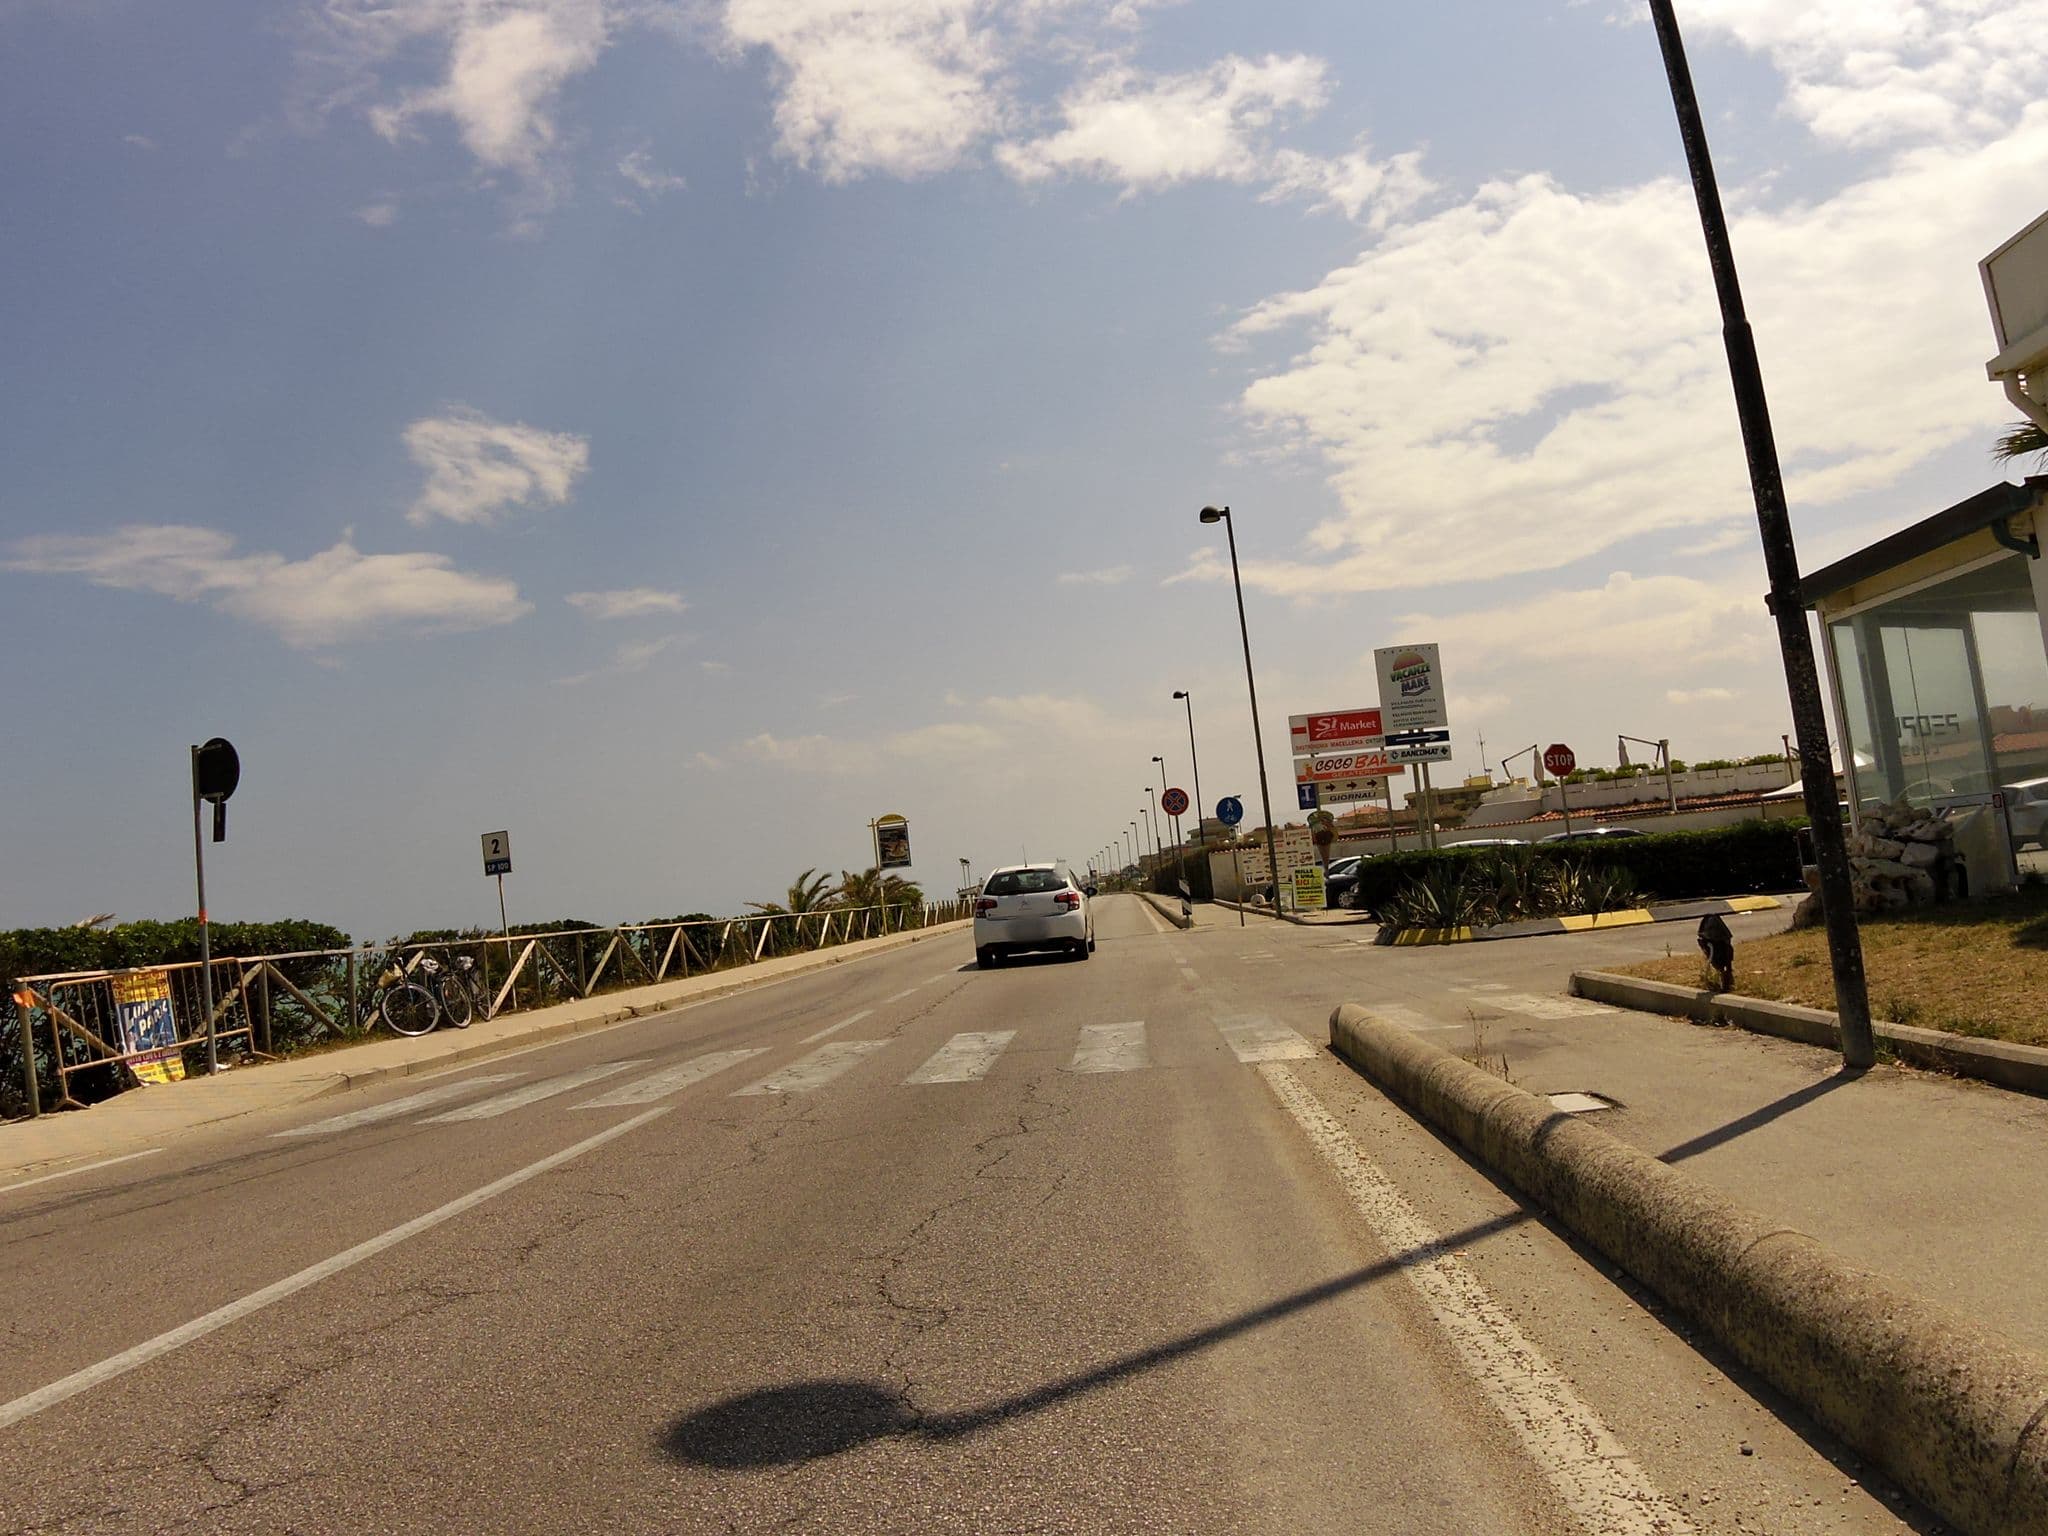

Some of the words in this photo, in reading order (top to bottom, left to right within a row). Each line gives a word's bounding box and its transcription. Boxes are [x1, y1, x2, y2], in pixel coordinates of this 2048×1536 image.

[1401, 676, 1429, 692] MARE
[1340, 720, 1377, 731] Market
[1400, 748, 1439, 757] BANCOMAT
[1315, 757, 1353, 772] COCO
[1546, 754, 1573, 767] STOP
[1331, 769, 1378, 777] GELATERIA
[1301, 785, 1311, 801] T
[1329, 791, 1377, 802] GIORNALI
[491, 838, 500, 854] 2
